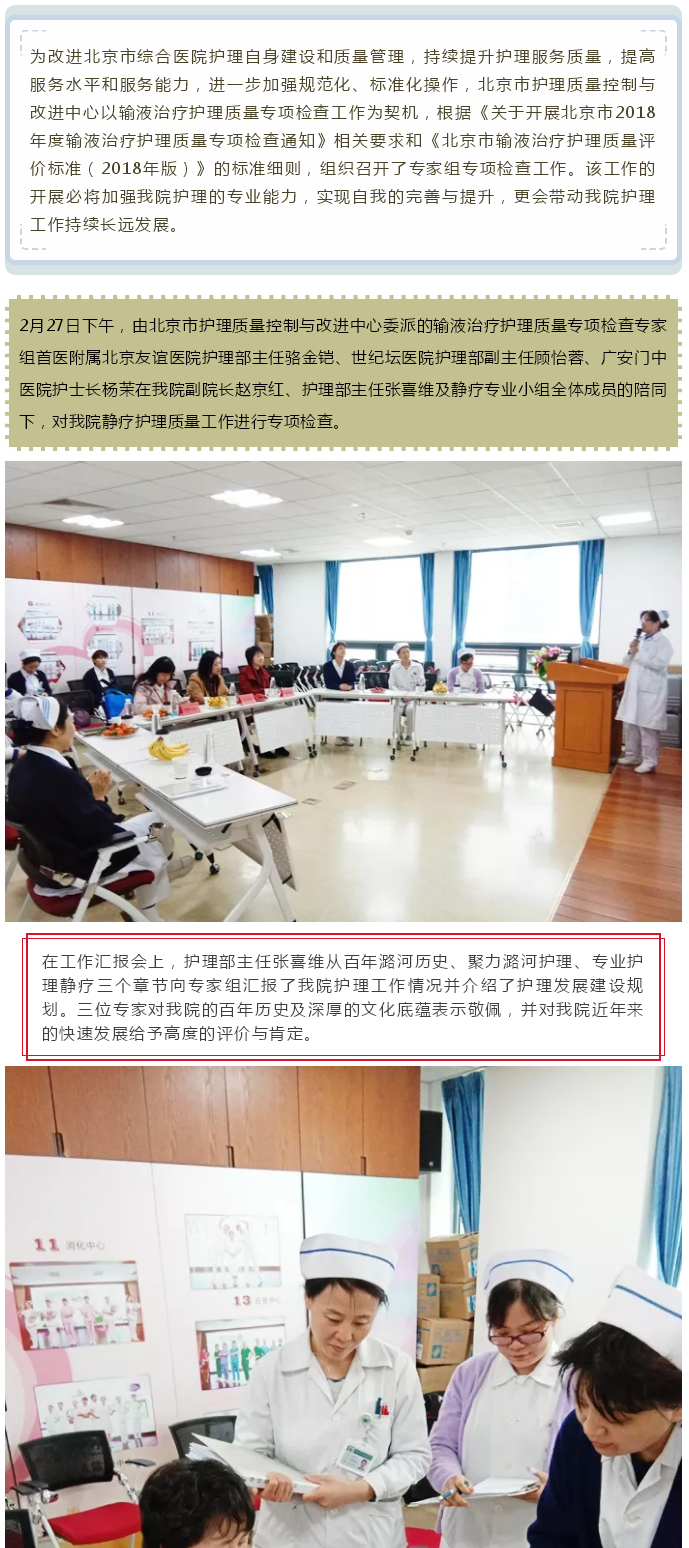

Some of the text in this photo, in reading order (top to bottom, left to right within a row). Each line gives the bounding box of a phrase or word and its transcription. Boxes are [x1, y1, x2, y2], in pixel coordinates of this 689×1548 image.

[34, 1238, 106, 1252] 11 消化中心
[234, 1295, 251, 1306] 13
